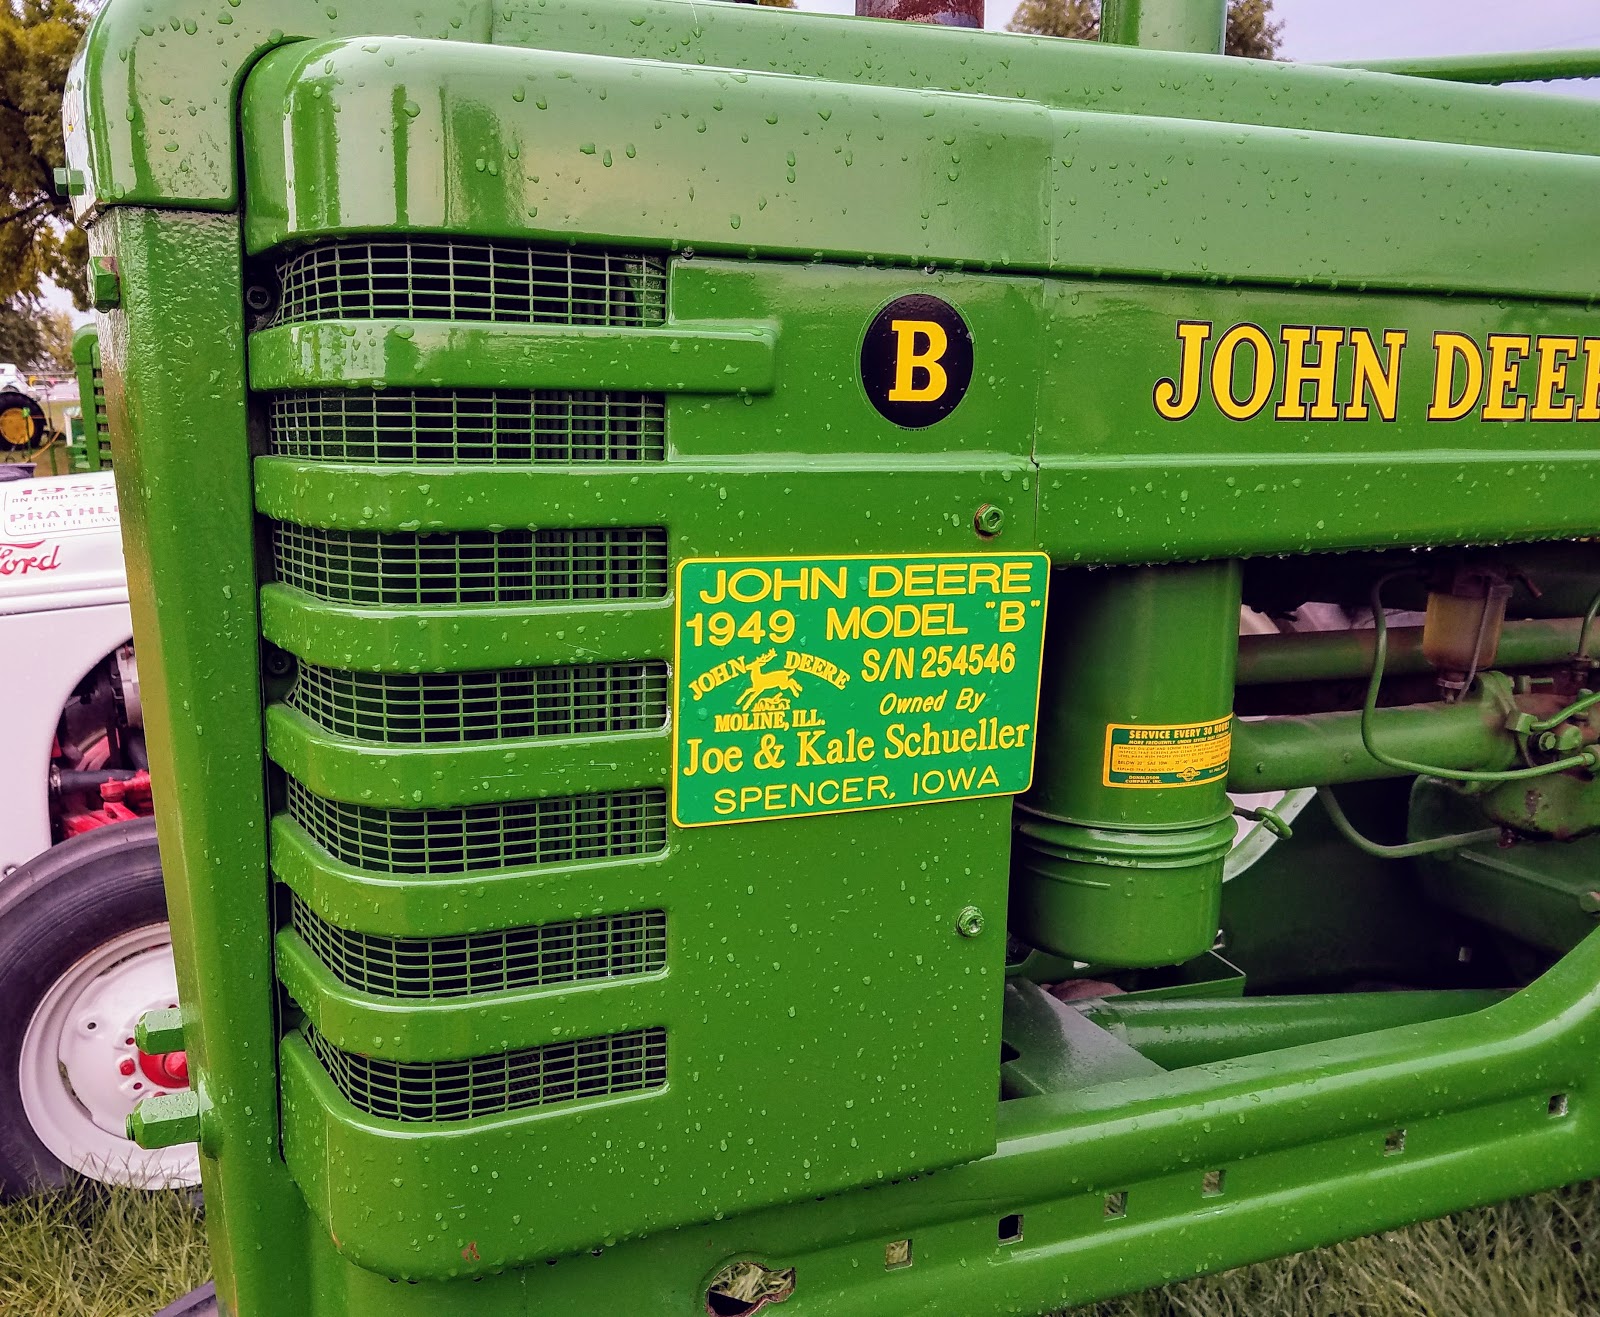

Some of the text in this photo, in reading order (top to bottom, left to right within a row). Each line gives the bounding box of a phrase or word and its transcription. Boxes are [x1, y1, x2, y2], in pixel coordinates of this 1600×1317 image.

[888, 320, 948, 402] B
[1153, 320, 1408, 422] JOHN
[699, 562, 1033, 604] JOHN DEERE
[685, 599, 1041, 647] 1949 MODEL "B"
[688, 651, 851, 701] JOHN DEERE
[861, 642, 1016, 682] S/N 254546
[714, 709, 826, 733] MOLINE, ILL.
[879, 687, 986, 716] Owned By
[683, 716, 1030, 776] Joe & Kale Schueller
[1129, 730, 1171, 739] SERVICE
[1174, 727, 1201, 739] EVERY
[1203, 726, 1213, 736] 30
[713, 765, 1000, 815] SPENCER, IOWA
